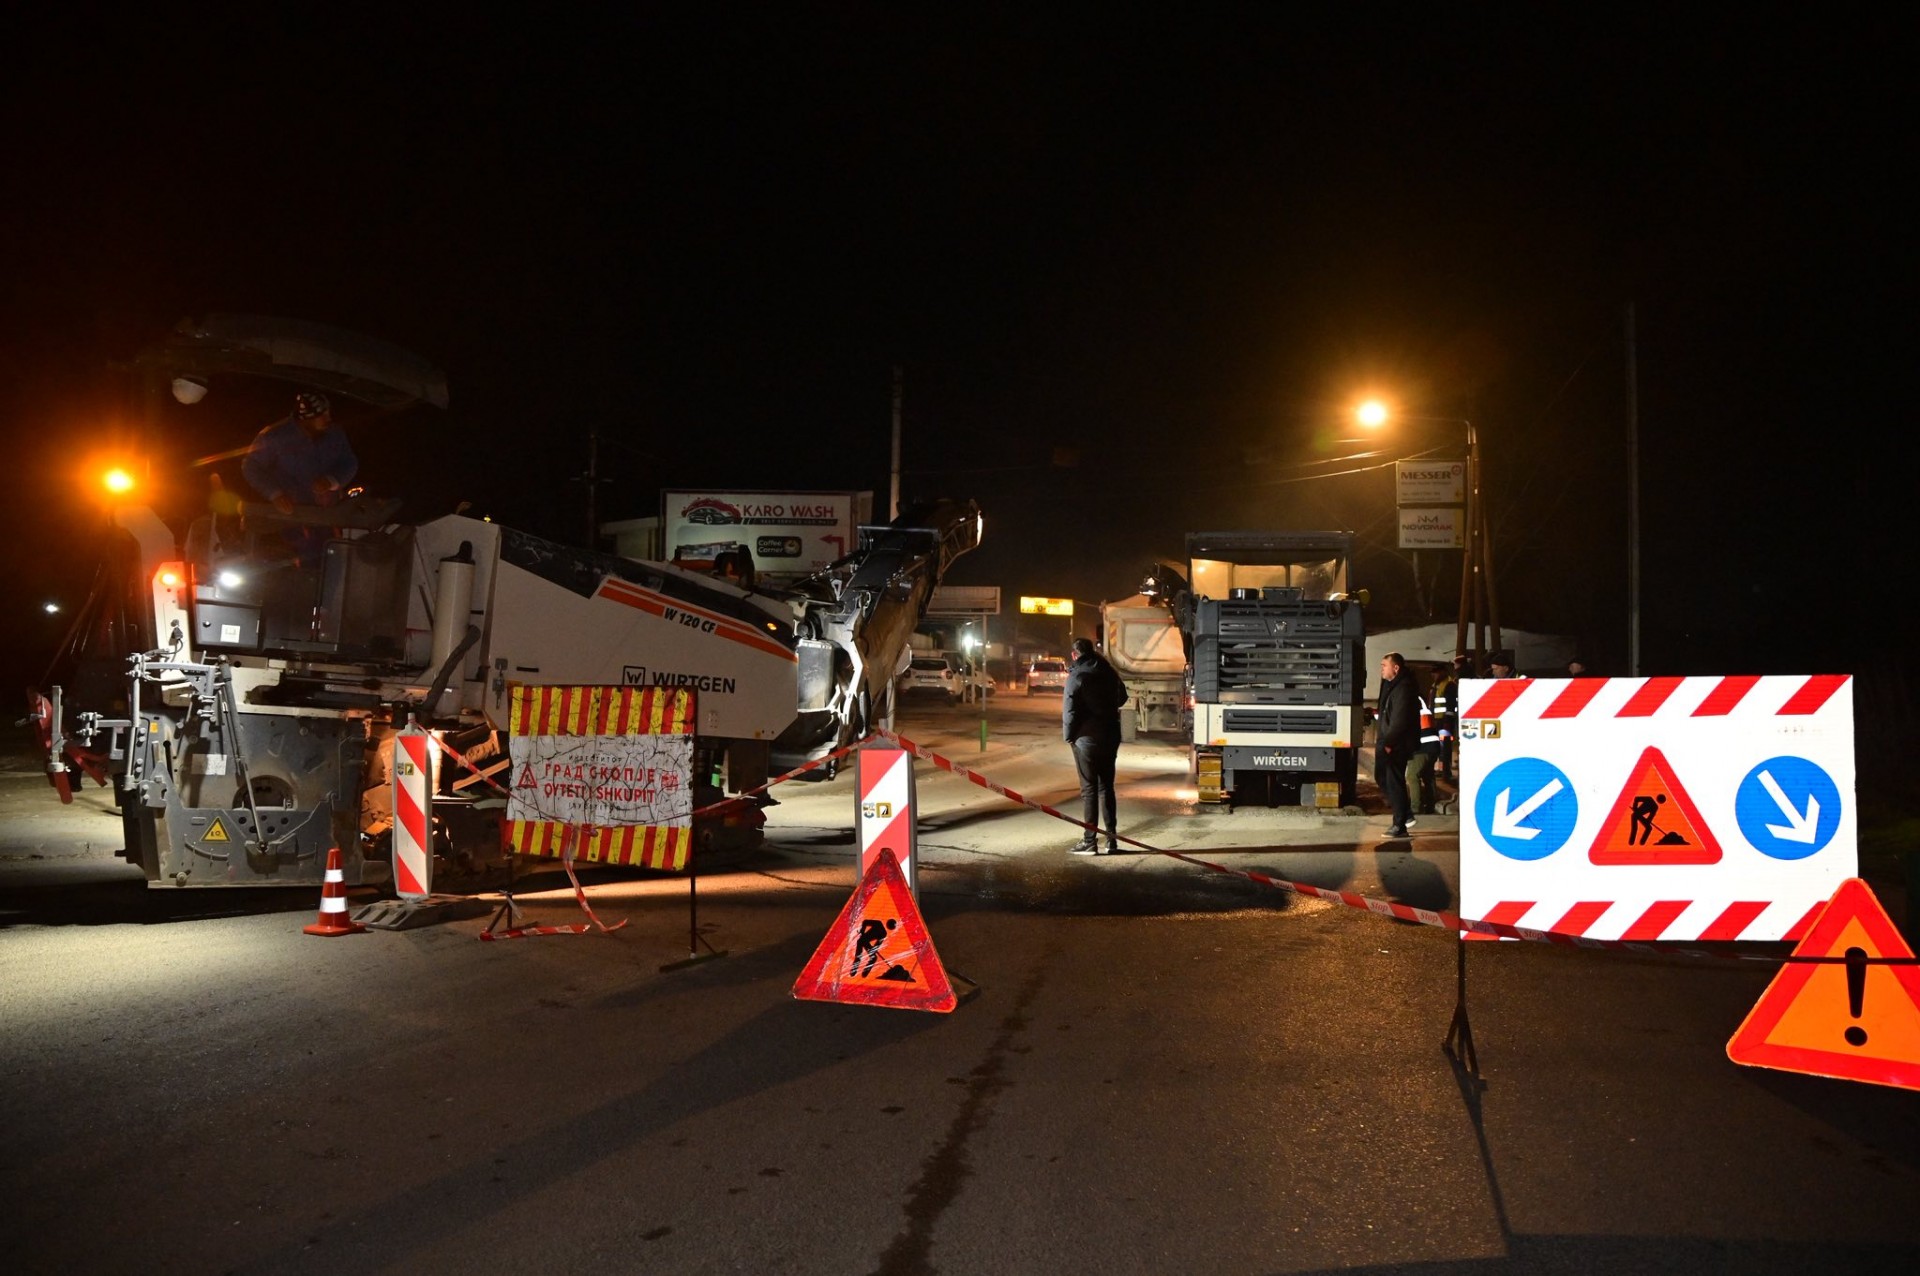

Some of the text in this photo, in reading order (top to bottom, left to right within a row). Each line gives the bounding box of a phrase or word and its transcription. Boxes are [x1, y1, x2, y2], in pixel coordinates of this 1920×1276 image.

[1401, 471, 1451, 480] MESSER
[743, 504, 834, 518] KARO WASH
[758, 539, 782, 547] Coffee
[664, 607, 716, 634] W 120 CF
[652, 671, 736, 694] WIRTGEN
[1253, 755, 1307, 767] WIRTGEN
[545, 763, 655, 782] ГРАД СКОПЈЕ
[596, 787, 656, 803] SHKUPIT
[1420, 912, 1438, 923] Stop
[1524, 929, 1543, 940] Stop
